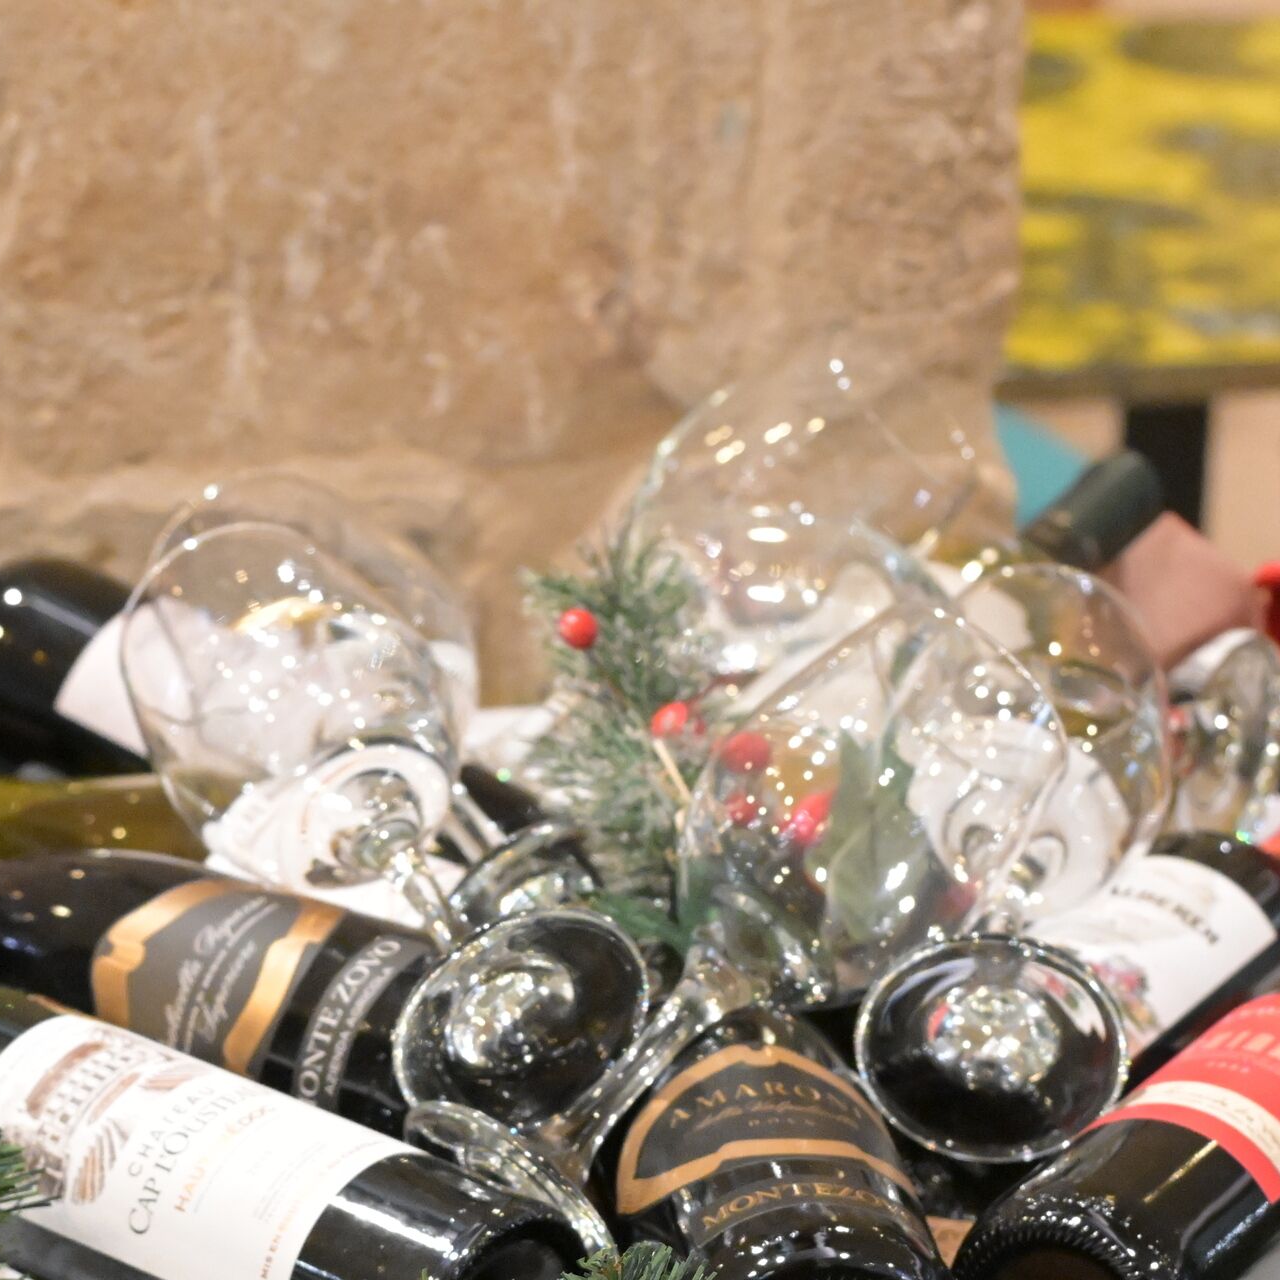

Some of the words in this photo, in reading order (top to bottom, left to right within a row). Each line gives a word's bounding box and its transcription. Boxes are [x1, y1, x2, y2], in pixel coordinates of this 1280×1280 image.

[299, 1005, 344, 1097] ONTE
[331, 937, 402, 1004] ZOVO
[128, 1177, 160, 1235] CAP
